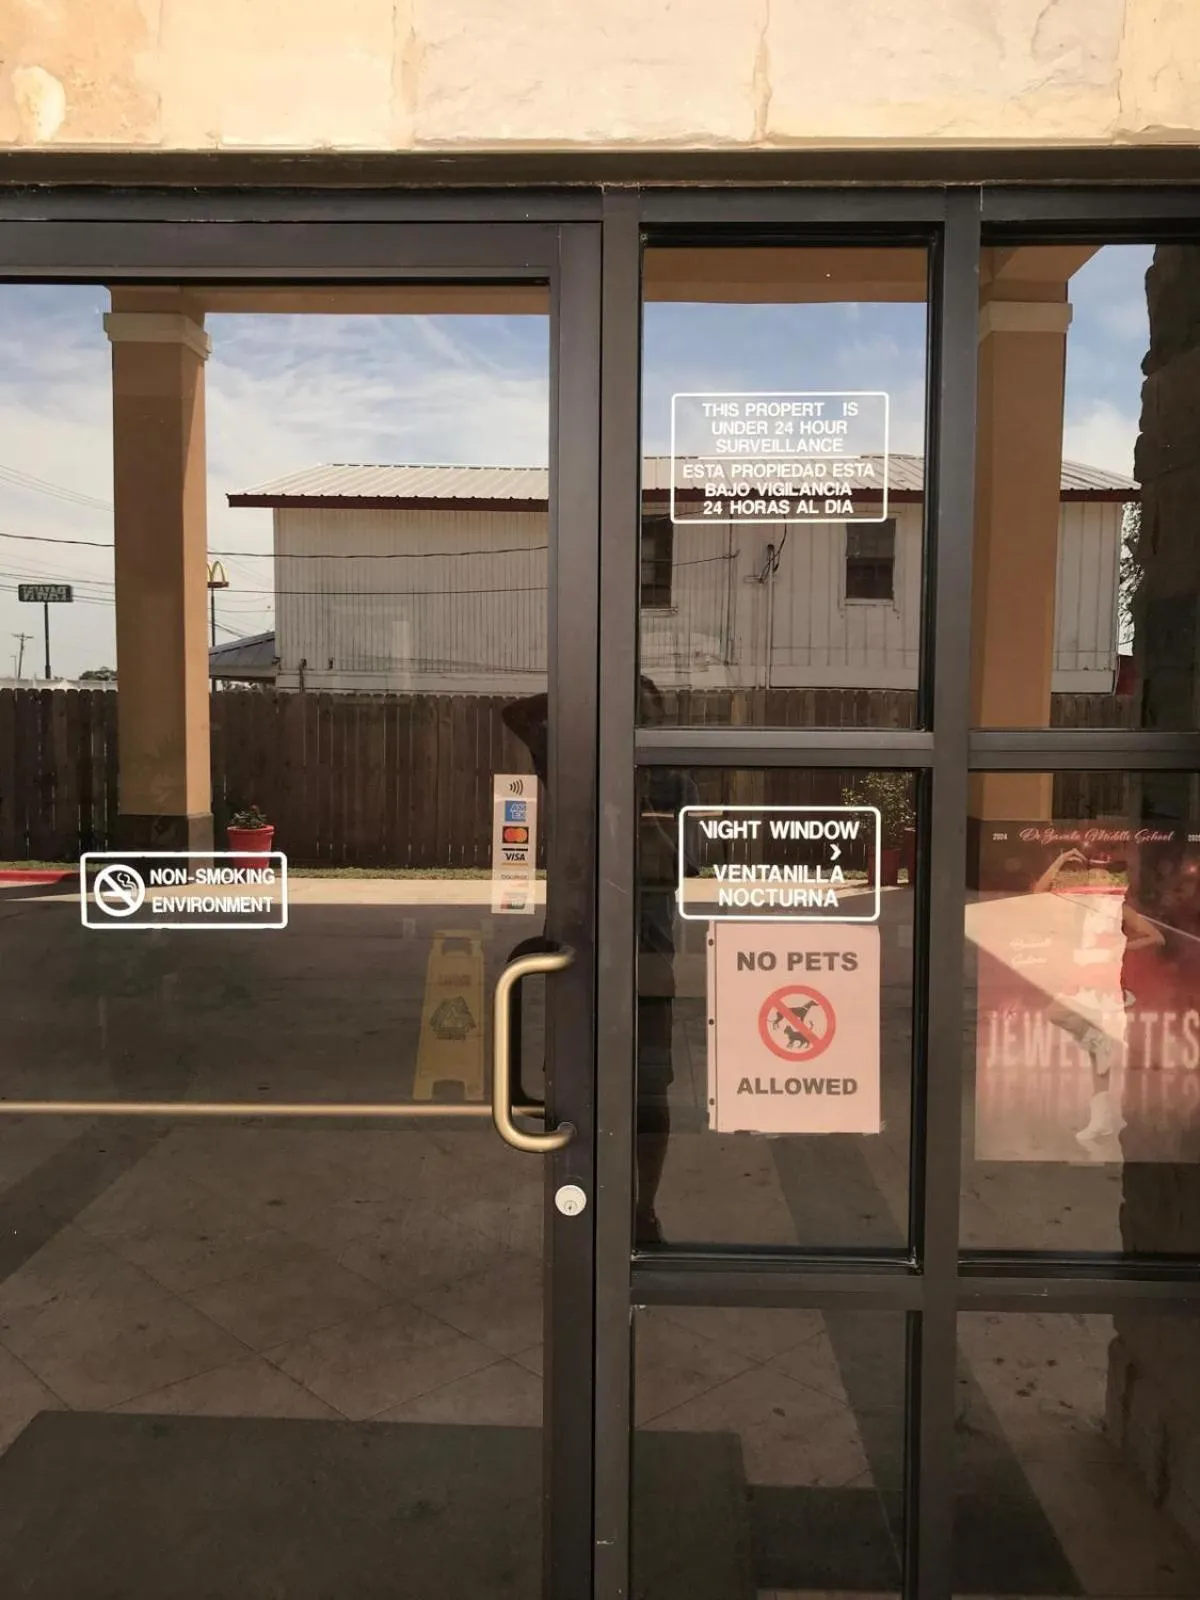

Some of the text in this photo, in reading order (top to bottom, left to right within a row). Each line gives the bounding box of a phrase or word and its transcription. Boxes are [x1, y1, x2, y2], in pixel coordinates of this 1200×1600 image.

[702, 402, 739, 417] THIS
[843, 402, 859, 416] IS
[711, 420, 848, 435] UNDER 24 HOUR
[715, 439, 843, 453] SURVEILLANCE
[683, 463, 875, 478] ESTA PROPIEDAD ESTA
[705, 482, 853, 497] BAJO VIGILANCIA
[703, 500, 854, 515] 24 HORAS AL DIA
[769, 820, 860, 840] WINDOW
[504, 852, 526, 861] VISA
[150, 867, 276, 885] NON-SMOKING
[714, 864, 845, 884] VENTANILLA
[152, 896, 274, 913] ENVIRONMENT
[719, 888, 839, 908] NOCTURNA
[736, 951, 859, 972] NO PETS
[736, 1077, 858, 1096] ALLOWED
